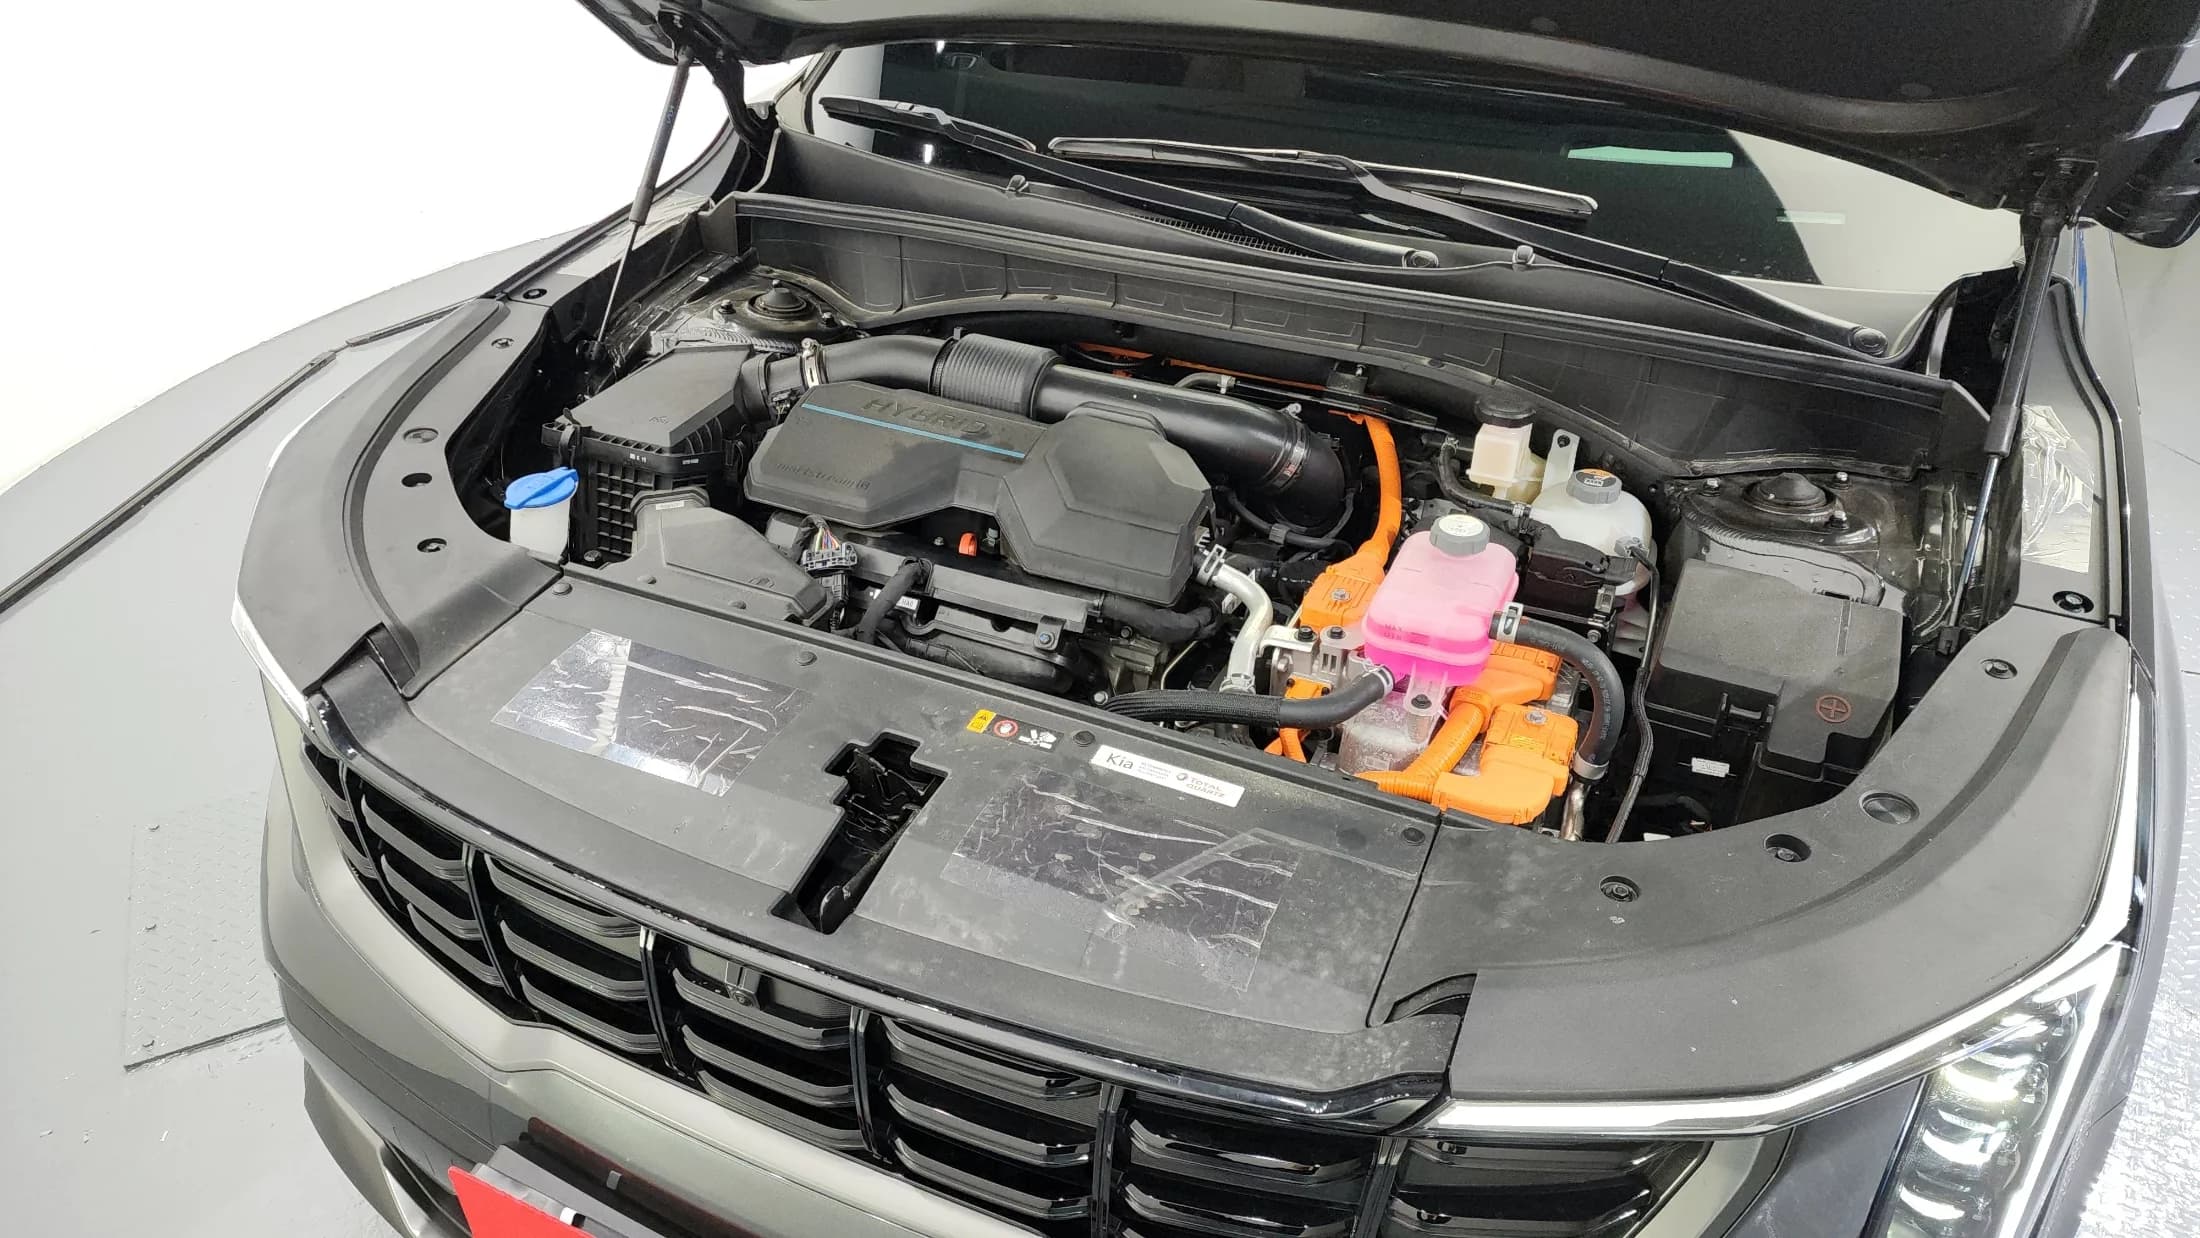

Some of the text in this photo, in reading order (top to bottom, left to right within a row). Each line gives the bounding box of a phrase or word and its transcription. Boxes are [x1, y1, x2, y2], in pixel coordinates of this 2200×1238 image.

[862, 398, 988, 437] HYBRID
[1385, 624, 1403, 633] MAX
[1106, 752, 1134, 770] Kia
[1186, 783, 1226, 798] QUARTZ
[1190, 777, 1225, 792] TOTAL
